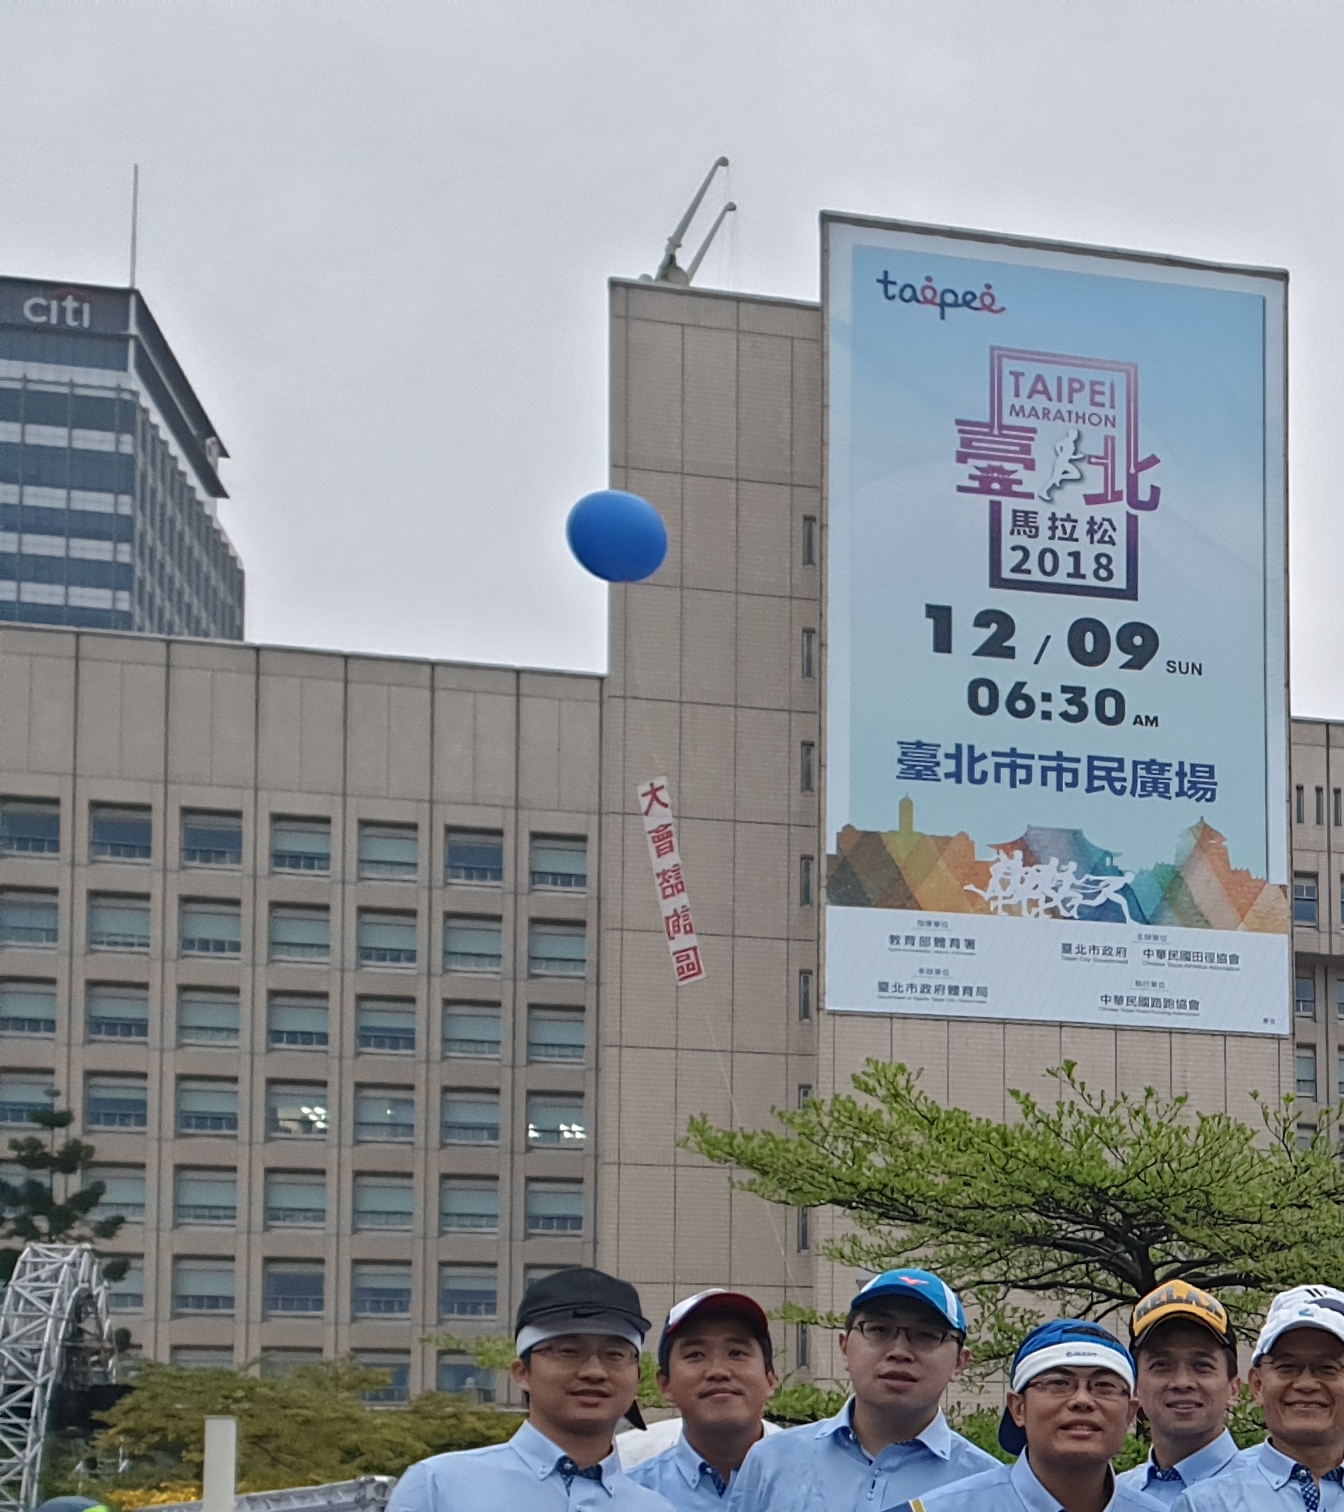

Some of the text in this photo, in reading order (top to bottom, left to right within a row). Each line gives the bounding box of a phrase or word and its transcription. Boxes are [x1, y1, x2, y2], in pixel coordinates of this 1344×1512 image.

[23, 294, 91, 328] citi
[876, 270, 1006, 320] taipei
[1009, 370, 1116, 409] TAIPEI
[1009, 404, 1117, 428] MARATHON
[1009, 508, 1117, 546] 馬拉松
[1009, 544, 1115, 582] 2018
[1165, 660, 1202, 676] SUN
[966, 676, 1159, 728] 06:30 AM
[896, 739, 1219, 803] 臺北市市民廣場
